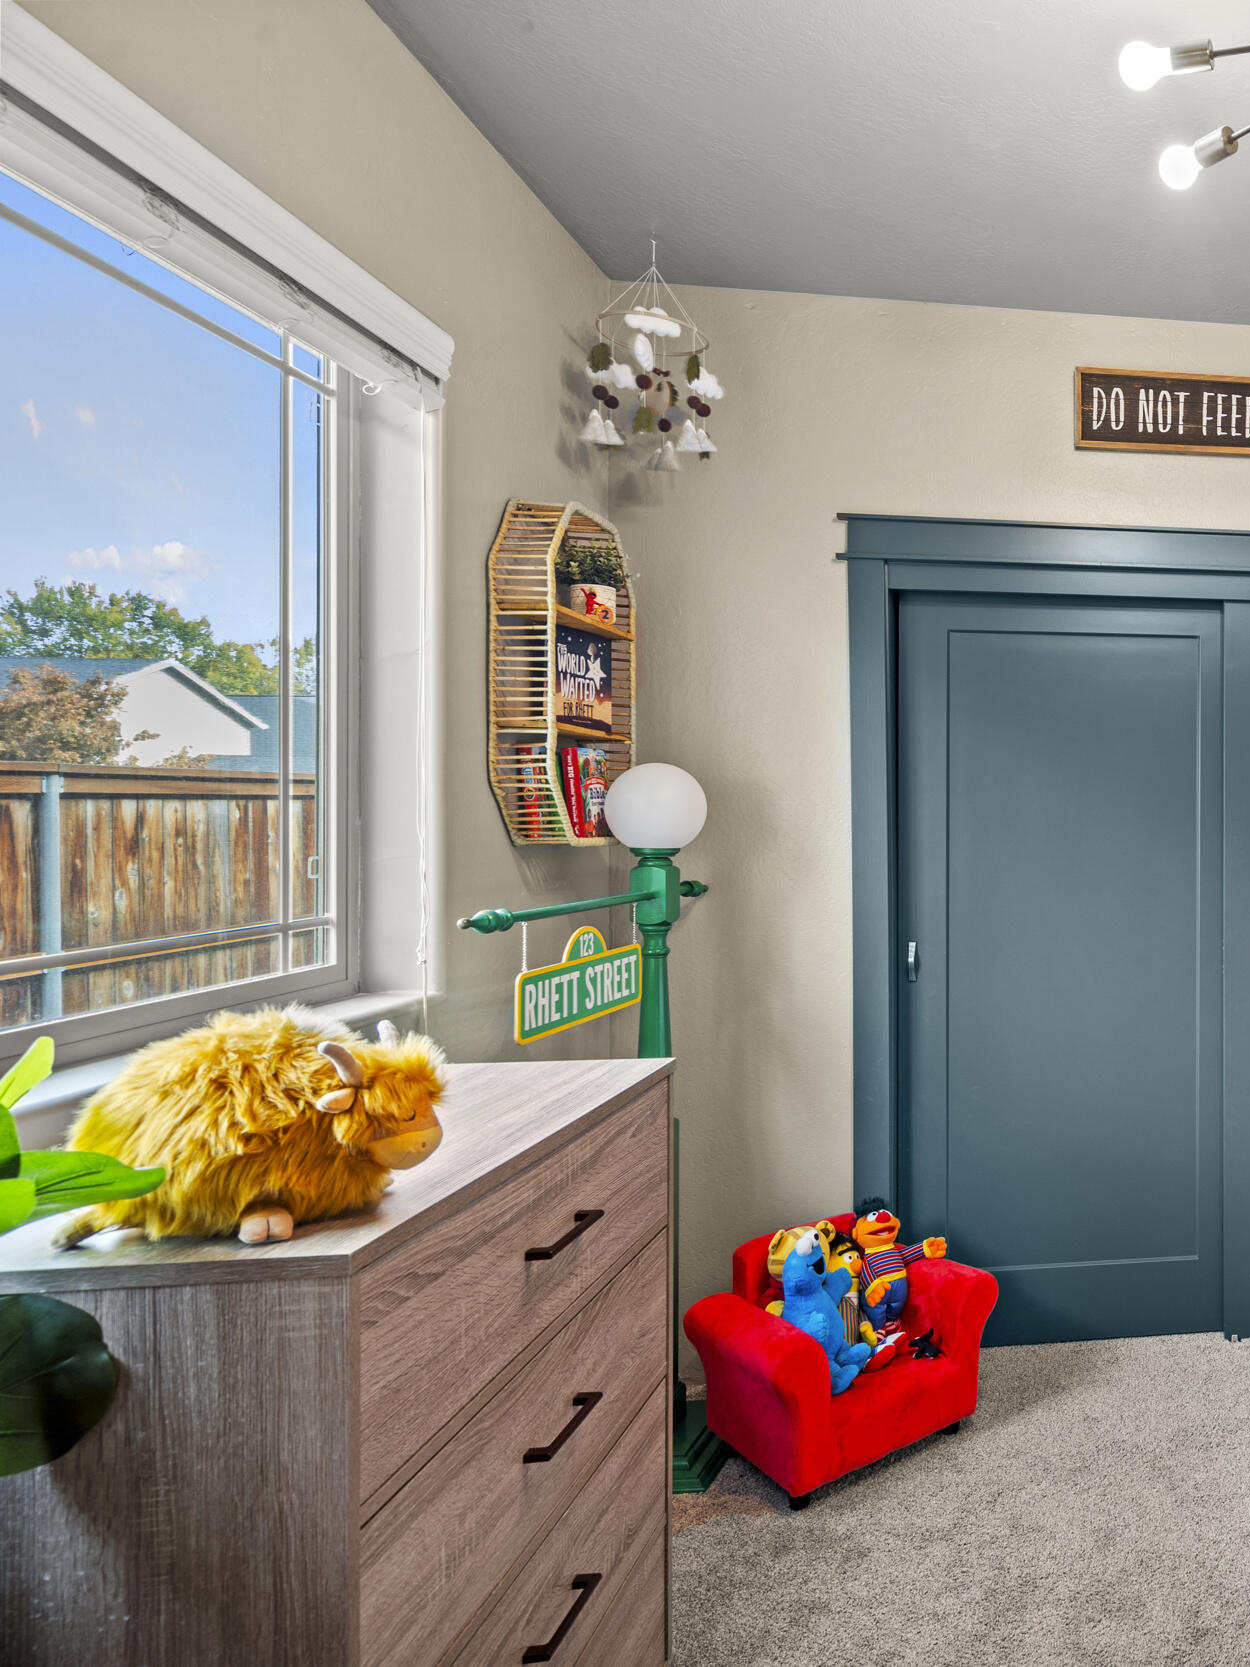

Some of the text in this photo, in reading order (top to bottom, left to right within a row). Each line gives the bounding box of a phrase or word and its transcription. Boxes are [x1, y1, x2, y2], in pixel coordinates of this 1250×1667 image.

[1092, 387, 1125, 431] DO
[1138, 388, 1190, 433] NOT
[601, 609, 610, 620] 2
[557, 652, 587, 676] WORLD
[560, 672, 596, 702] WAITED
[563, 701, 594, 720] FOR RHETT
[579, 932, 594, 957] 123
[524, 954, 637, 1031] RHETT STREET
